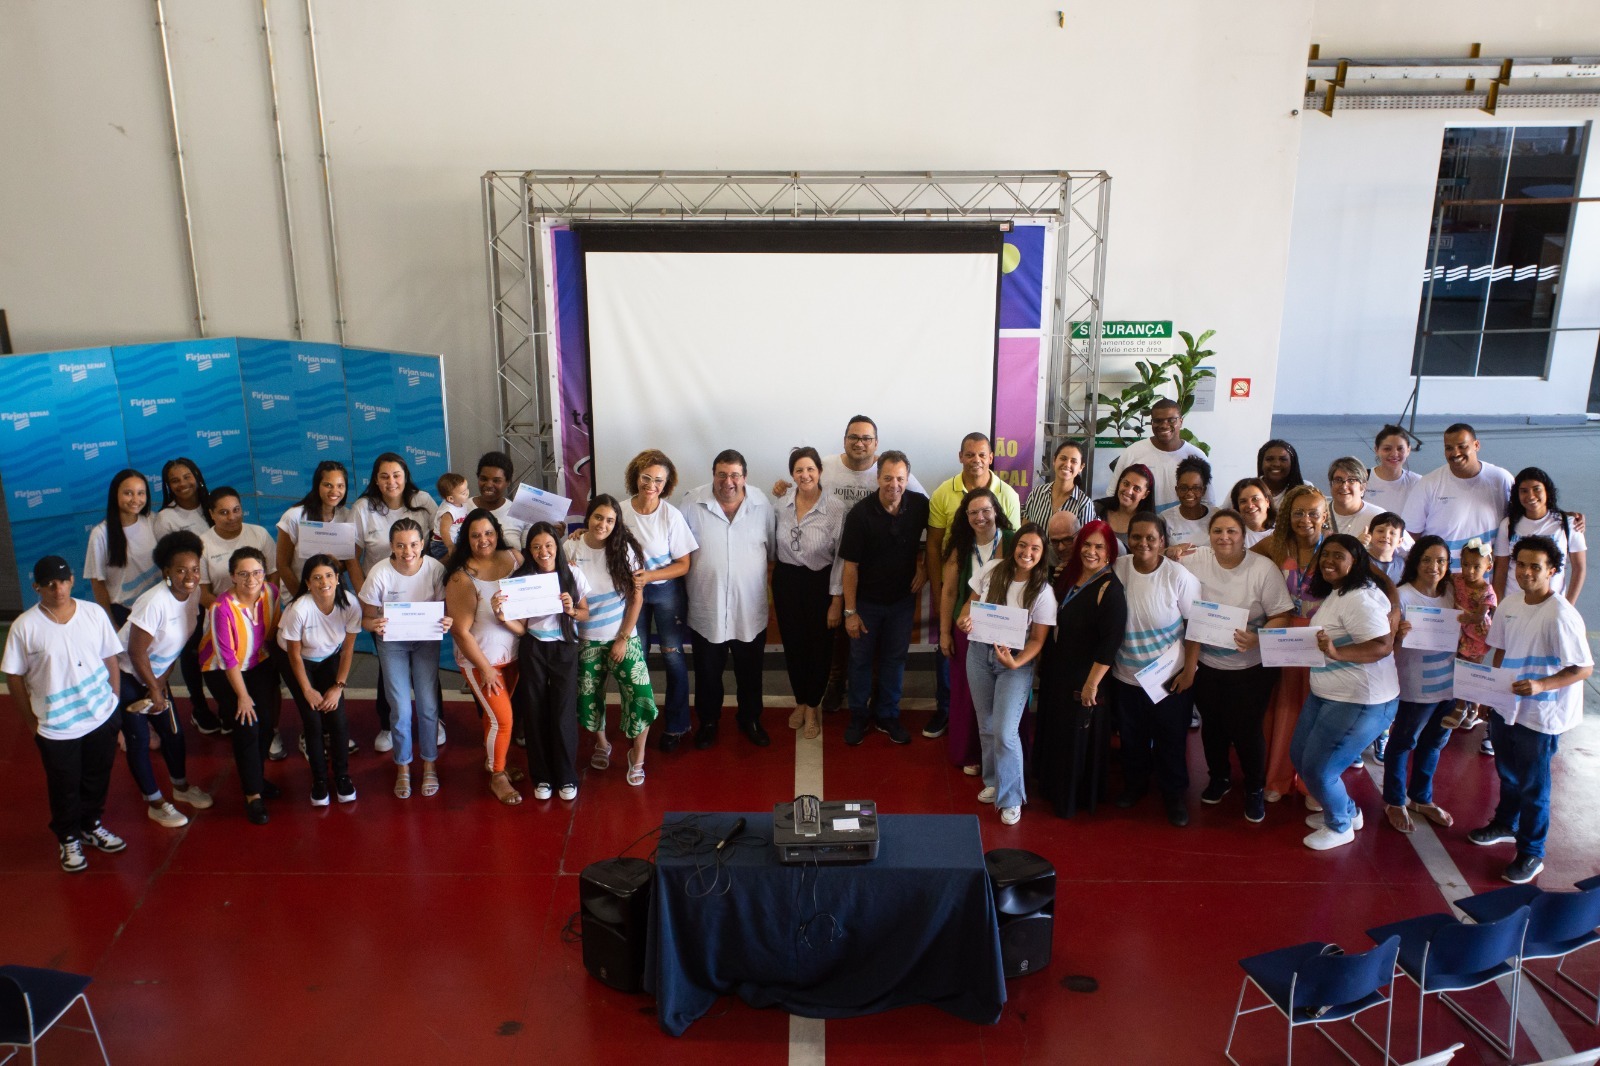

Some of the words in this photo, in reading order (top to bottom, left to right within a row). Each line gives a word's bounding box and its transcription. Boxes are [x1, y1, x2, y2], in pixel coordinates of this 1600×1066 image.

[185, 352, 211, 361] Firjan
[298, 354, 320, 363] Firjan
[59, 363, 86, 372] Firjan
[398, 367, 420, 377] Firjan
[252, 391, 274, 400] Firjan
[130, 398, 156, 407] Firjan
[355, 402, 376, 411] Firjan
[1, 411, 28, 420] Firjan
[29, 410, 49, 418] SENAI
[196, 429, 221, 439] Firjan
[306, 431, 328, 441] Firjan
[72, 441, 98, 451] Firjan
[98, 440, 118, 448] SENAI
[406, 445, 426, 456] Firjan
[261, 466, 283, 476] Firjan
[14, 489, 42, 499] Firjan
[833, 487, 855, 496] JOHN
